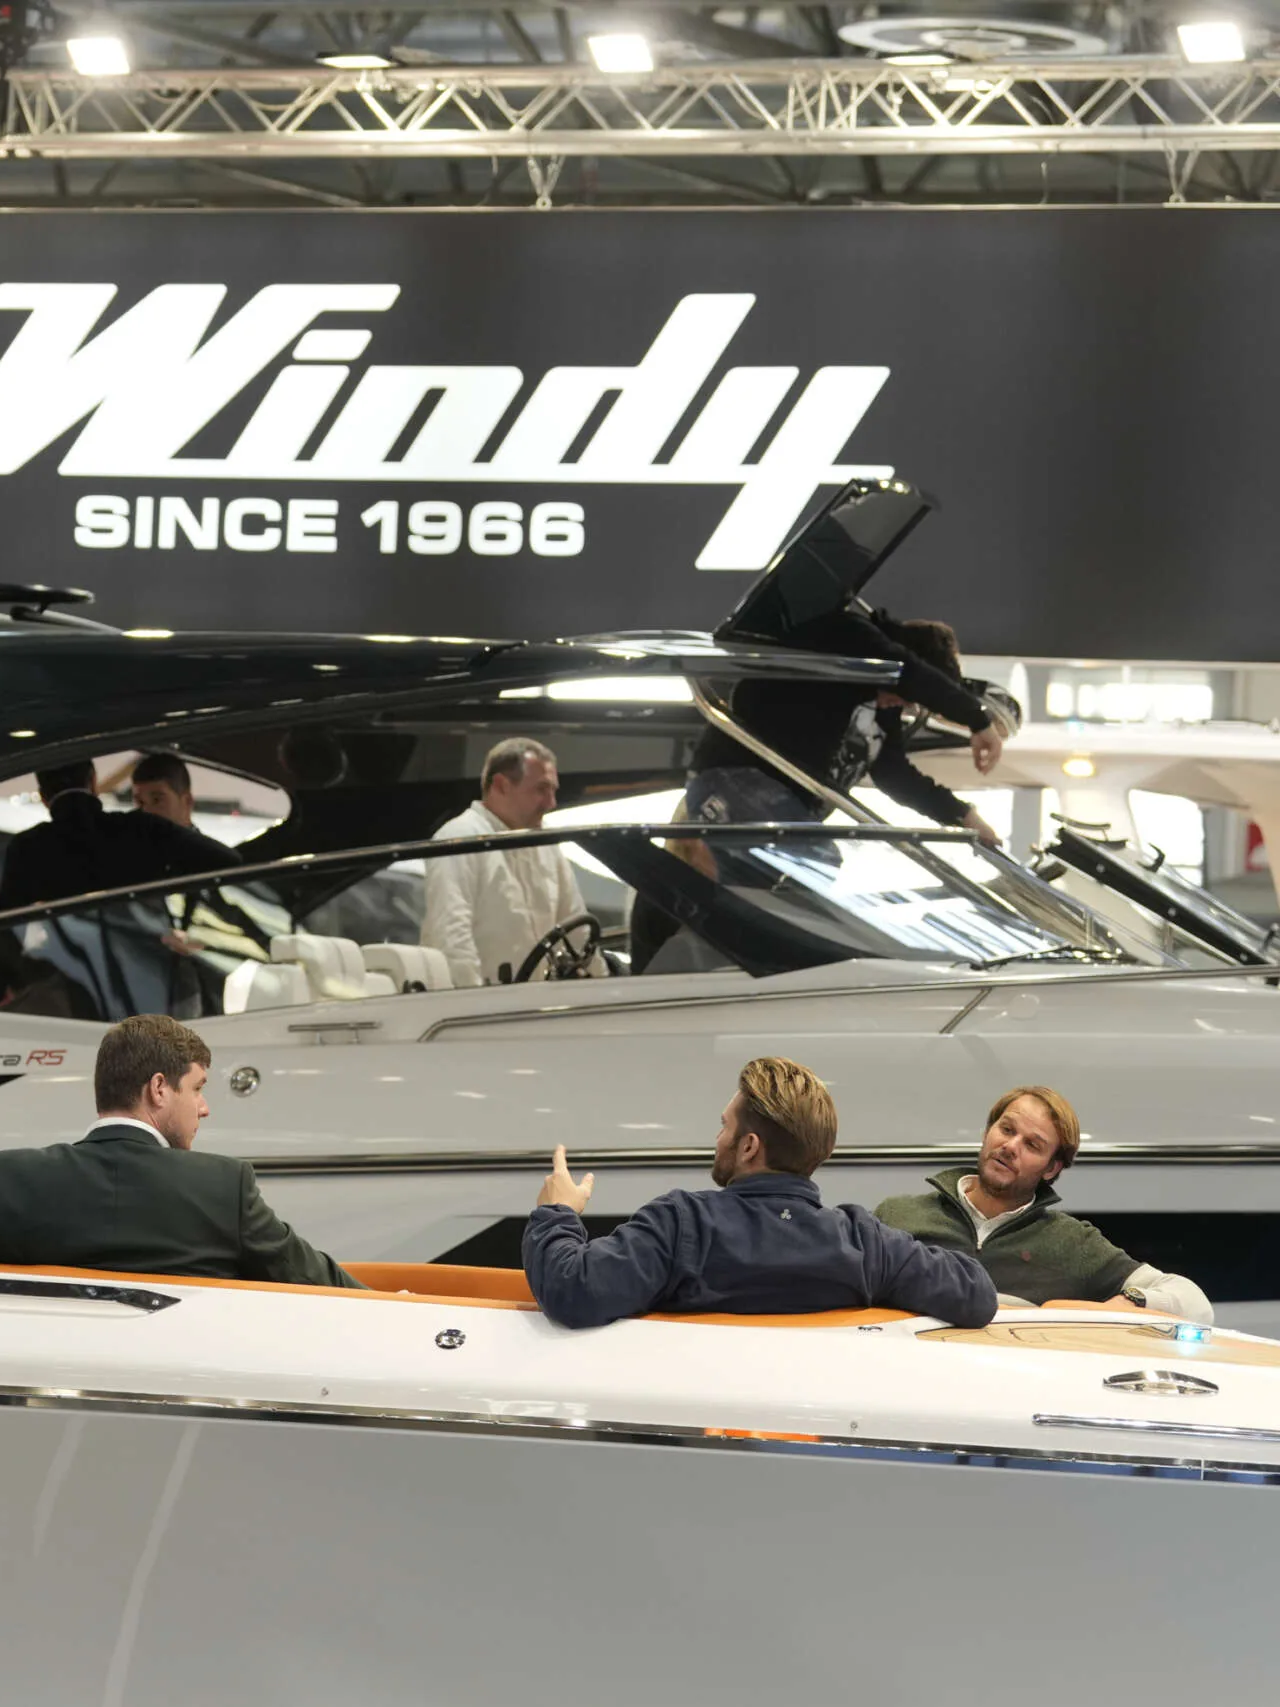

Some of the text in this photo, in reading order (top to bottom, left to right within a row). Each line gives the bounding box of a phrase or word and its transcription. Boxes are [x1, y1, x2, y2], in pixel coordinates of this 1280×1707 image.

[74, 494, 586, 557] SINCE 1966
[26, 1049, 68, 1066] RS
